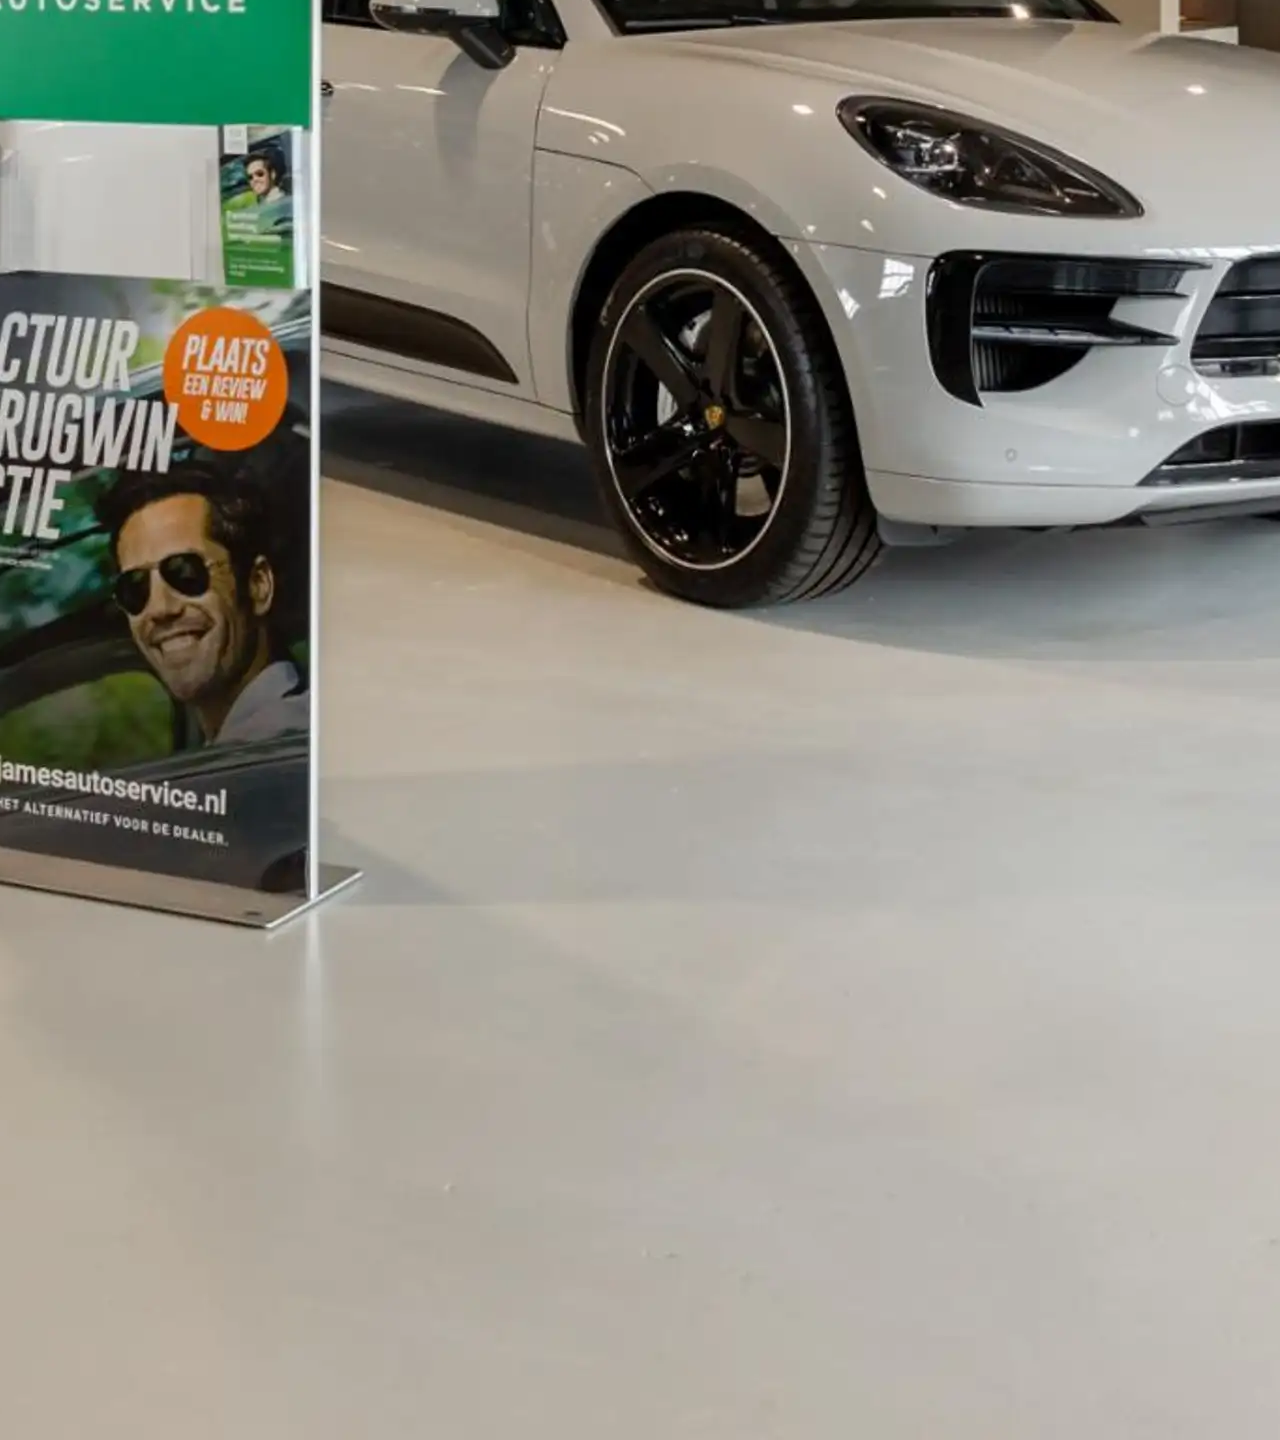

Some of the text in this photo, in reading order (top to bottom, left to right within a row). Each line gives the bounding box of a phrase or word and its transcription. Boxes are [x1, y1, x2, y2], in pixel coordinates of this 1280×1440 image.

[182, 334, 269, 375] PLAATS
[182, 373, 267, 400] EEN REVIEW
[215, 400, 248, 424] WIN!
[23, 801, 111, 826] ALTERNATIEF
[113, 815, 149, 833] VOOR
[152, 821, 171, 836] DE
[173, 824, 229, 847] DEALER.
